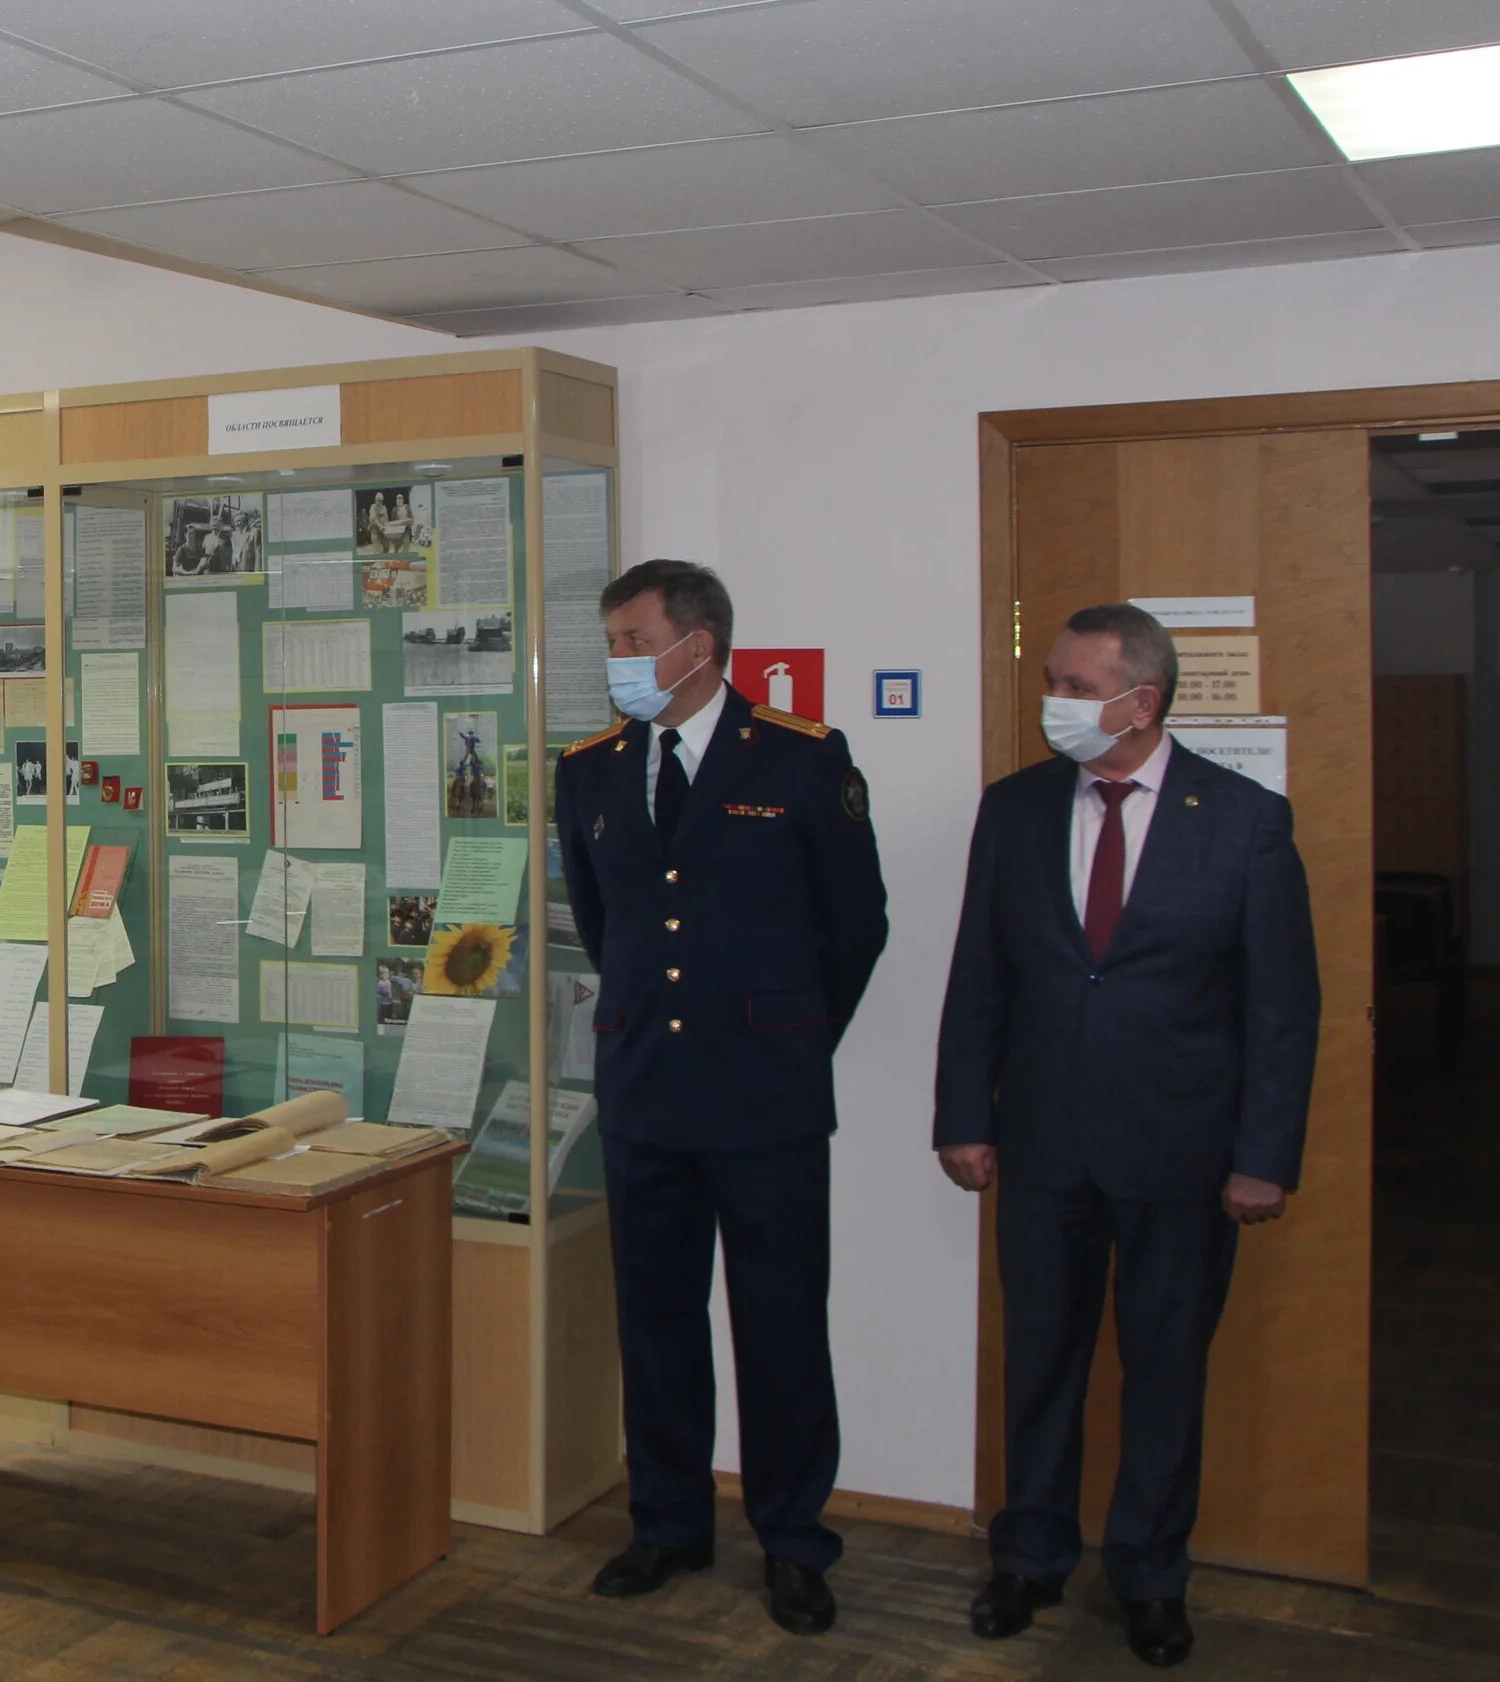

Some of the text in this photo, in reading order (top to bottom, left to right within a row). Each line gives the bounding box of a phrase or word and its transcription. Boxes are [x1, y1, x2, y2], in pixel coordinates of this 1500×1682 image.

[225, 416, 324, 432] ОБЛАСТИ ПОСВЯЩАЕТСЯ
[889, 694, 904, 705] 01
